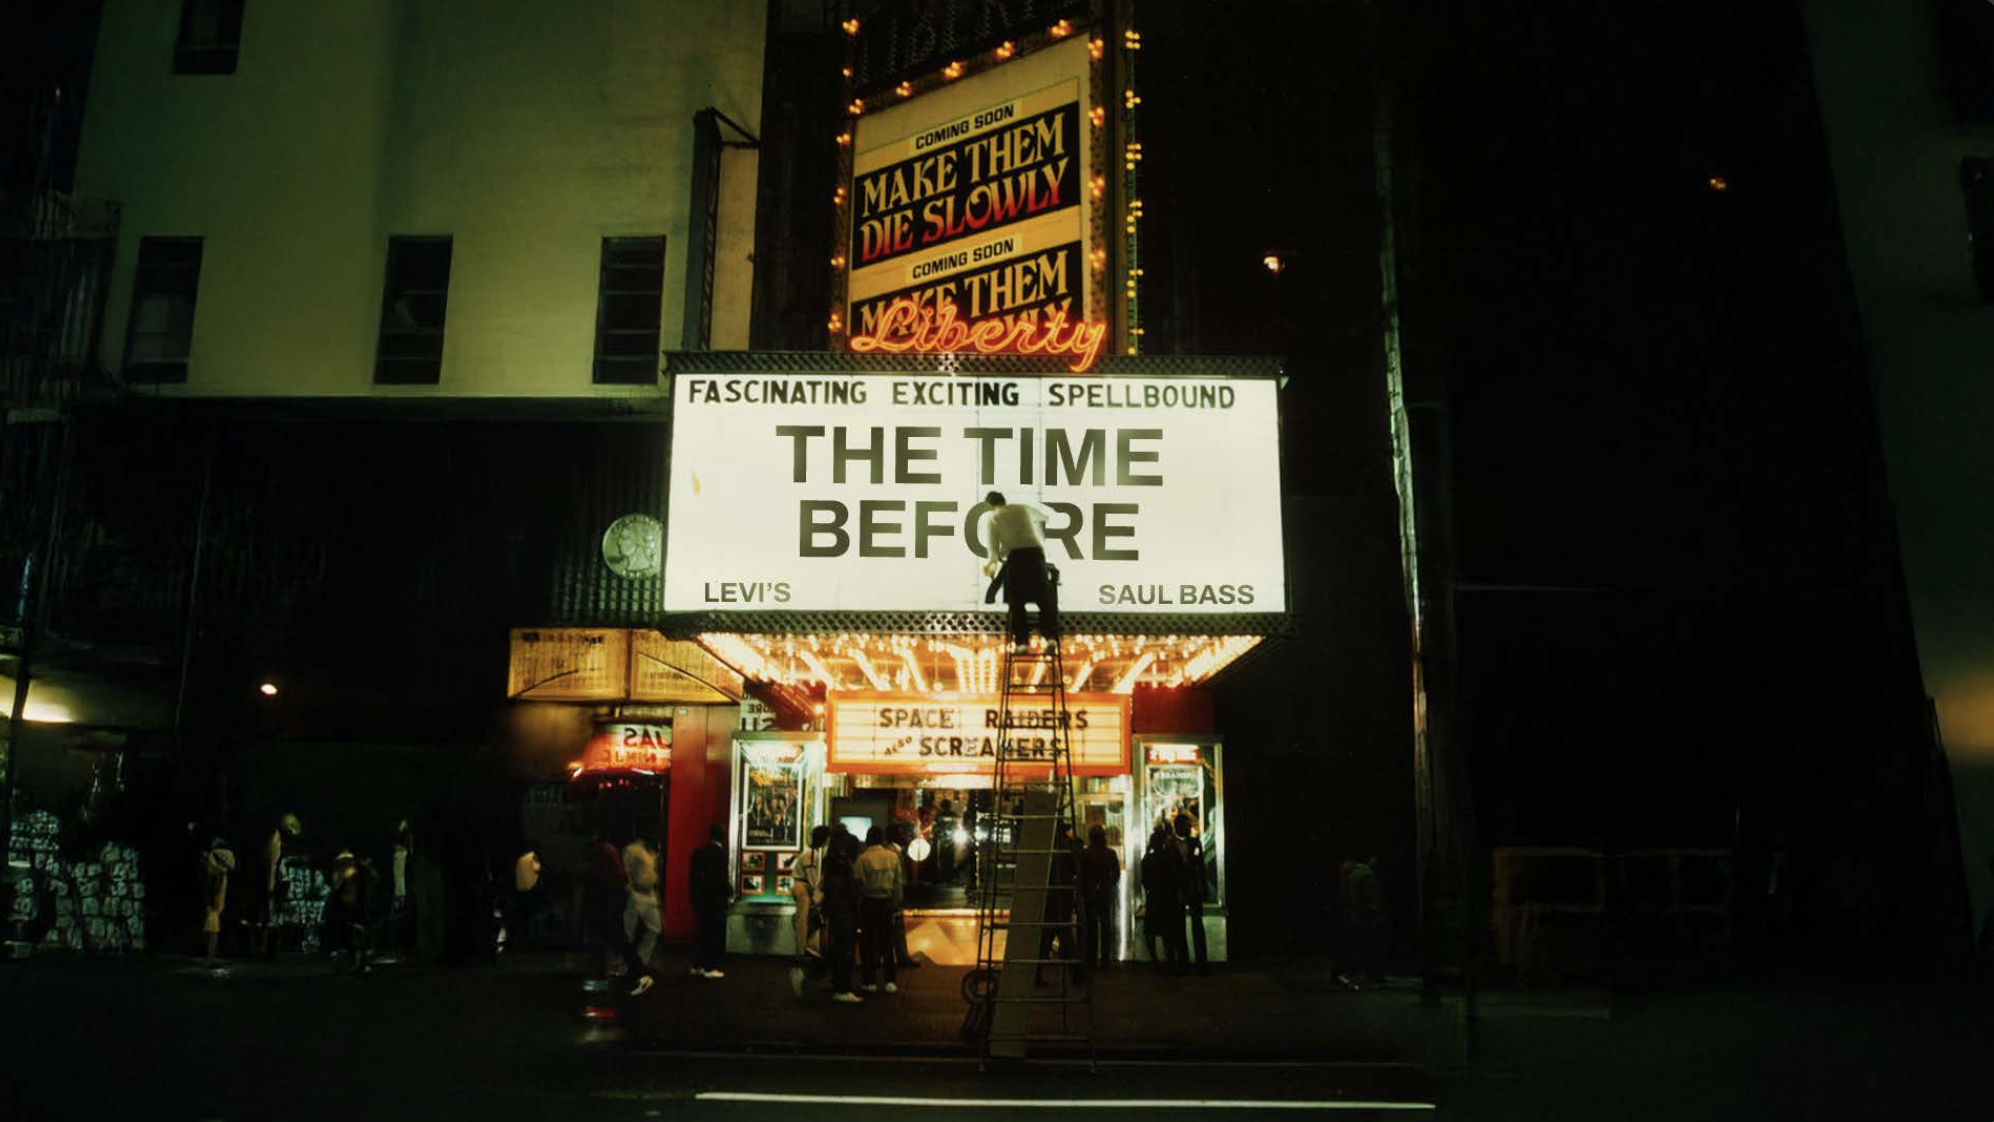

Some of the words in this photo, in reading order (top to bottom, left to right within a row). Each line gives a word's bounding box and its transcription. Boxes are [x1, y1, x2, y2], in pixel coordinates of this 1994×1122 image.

[915, 120, 970, 150] COMING
[974, 104, 1014, 129] SOON
[862, 150, 958, 218] MAKE
[964, 112, 1066, 183] THEM
[860, 209, 914, 262] DIE
[922, 157, 1070, 244] SLOWLY
[912, 252, 968, 279] COMING
[973, 238, 1014, 261] SOON
[964, 250, 1069, 318] THEM
[850, 299, 1107, 372] Liberty
[689, 379, 868, 405] FASCINATING
[892, 381, 1020, 407] EXCITING
[1048, 383, 1236, 409] SPELLBOUND
[776, 425, 942, 484] THE
[964, 427, 1164, 487] TIME
[1099, 584, 1173, 605] SAUL
[1179, 584, 1255, 605] BASS
[879, 708, 955, 728] SPACE
[985, 709, 1088, 730] RAIDERS
